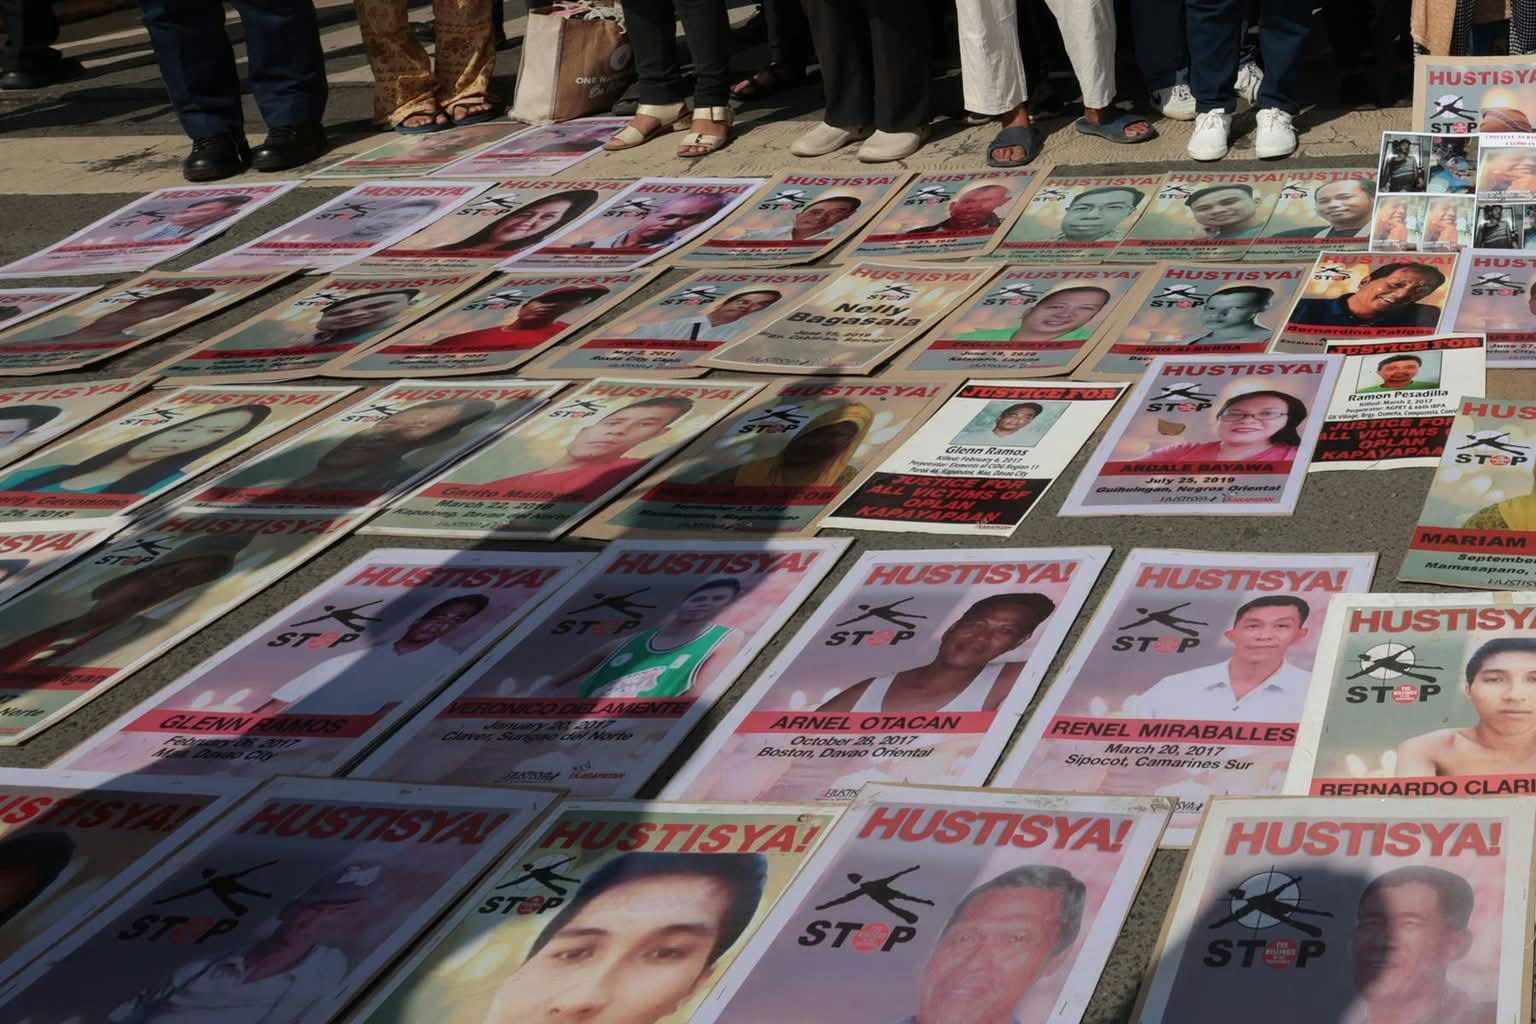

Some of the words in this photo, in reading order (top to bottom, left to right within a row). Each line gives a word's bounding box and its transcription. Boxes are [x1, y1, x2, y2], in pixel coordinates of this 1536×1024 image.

[834, 302, 907, 319] Nelly
[787, 312, 922, 330] Bagasala
[1162, 363, 1324, 377] HUSTISYA!
[962, 387, 1062, 400] JUSTICE
[1064, 388, 1118, 400] FOR
[1348, 392, 1391, 402] Ramon
[1394, 389, 1449, 399] Pesadilla
[945, 445, 983, 456] Glenn
[986, 446, 1029, 457] Ramos
[1455, 453, 1528, 466] STOP
[1420, 532, 1526, 549] MARIAM
[864, 562, 1080, 586] HUSTISYA!
[1135, 567, 1349, 593] HUSTISYA!
[825, 629, 915, 646] STOP
[1112, 635, 1200, 653] STOP
[1346, 684, 1441, 704] STOP
[159, 714, 254, 732] GLENN
[254, 717, 350, 734] RAMOS
[770, 716, 852, 729] ARNEL
[858, 715, 962, 730] OTACAN
[1051, 720, 1130, 738] RENEL
[1137, 723, 1297, 742] MIRABALLES
[790, 735, 853, 746] October
[854, 735, 879, 747] 28,
[882, 735, 918, 745] 2017
[1104, 743, 1156, 756] March
[1159, 744, 1183, 758] 20,
[1188, 745, 1225, 757] 2017
[1065, 753, 1130, 768] Sipocot,
[1135, 756, 1220, 770] Camarines
[1224, 758, 1254, 770] Sur
[540, 821, 821, 853] HUSTISYA!
[858, 807, 1132, 854] HUSTISYA!
[1224, 821, 1502, 857] HUSTISYA!
[797, 920, 917, 952] STOP
[1203, 939, 1325, 969] STOP
